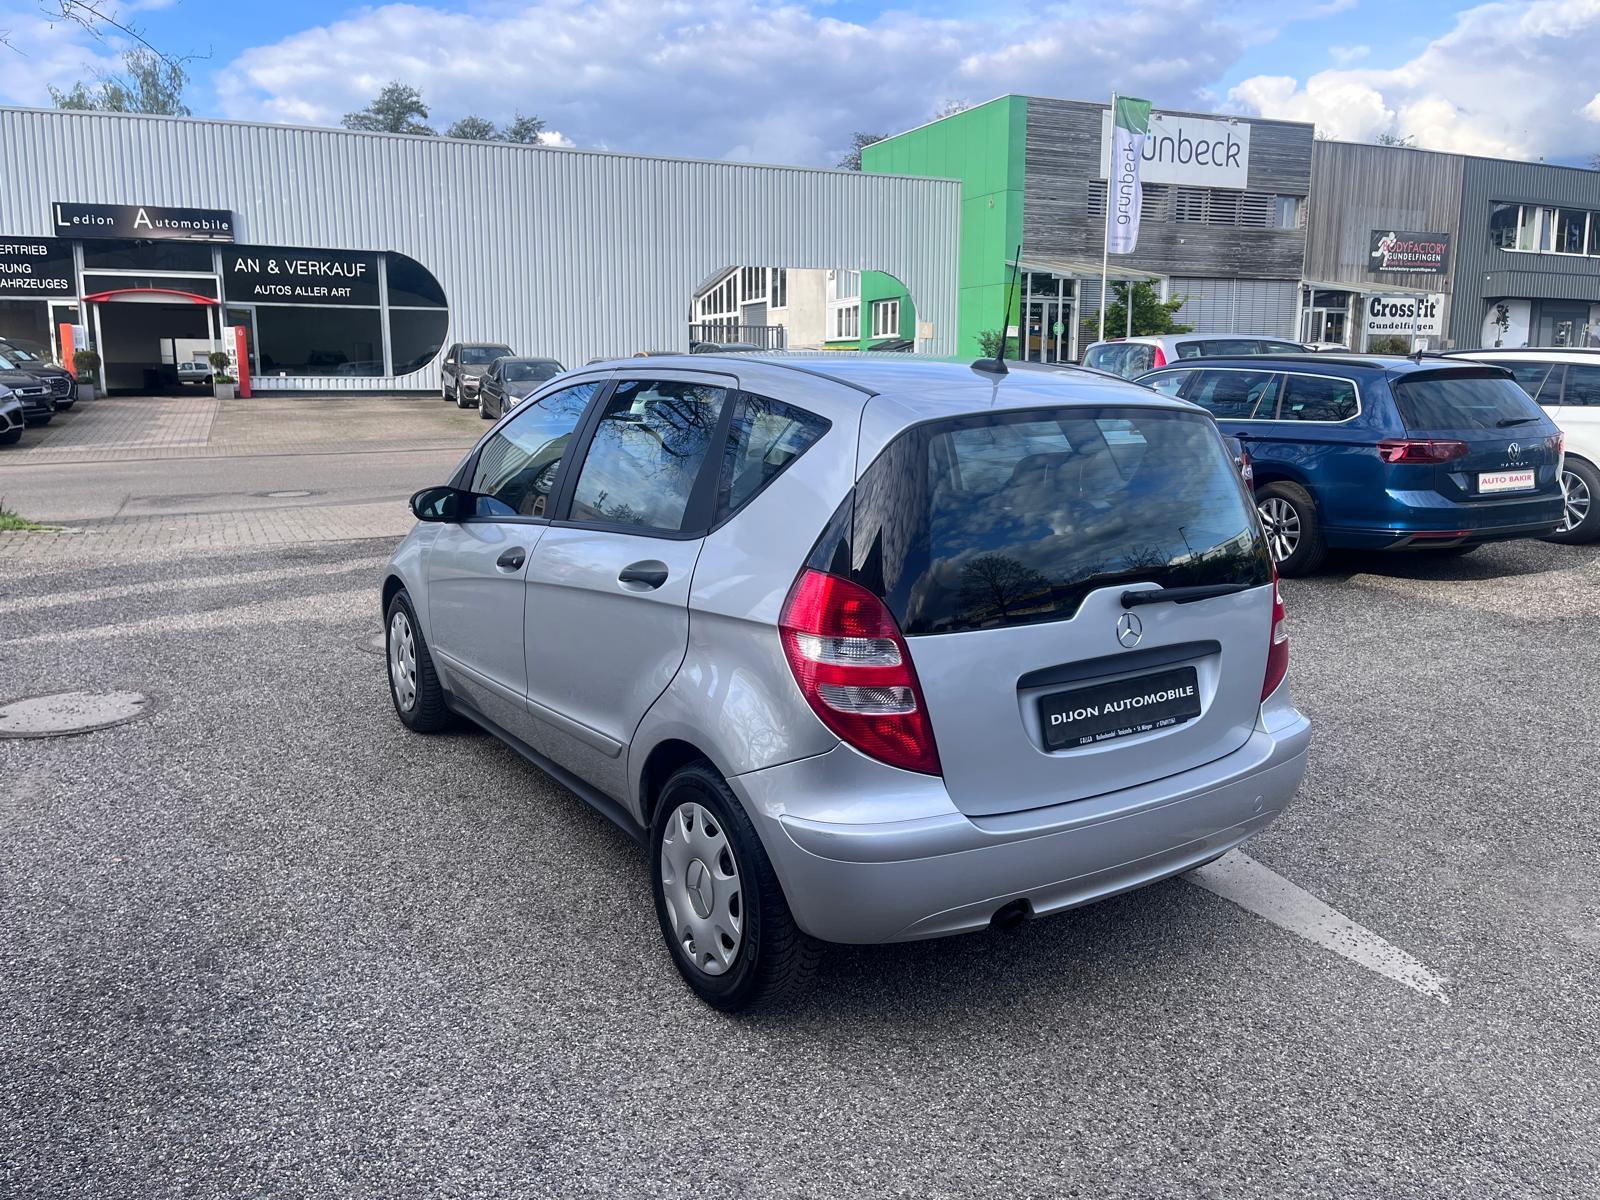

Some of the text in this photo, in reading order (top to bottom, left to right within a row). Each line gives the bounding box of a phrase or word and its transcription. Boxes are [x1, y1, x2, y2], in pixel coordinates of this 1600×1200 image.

[1141, 128, 1240, 168] ünbeck
[57, 204, 229, 231] Ledion Automobile
[1388, 252, 1440, 261] GUNDELFINGEN
[234, 258, 367, 278] AN & VERKAUF
[0, 277, 69, 290] AHRZEUGES
[254, 284, 351, 298] AUTOS ALLER ART
[1481, 474, 1532, 485] AUTO BAKIR
[1051, 685, 1194, 726] DIJON AUTOMOBILE
